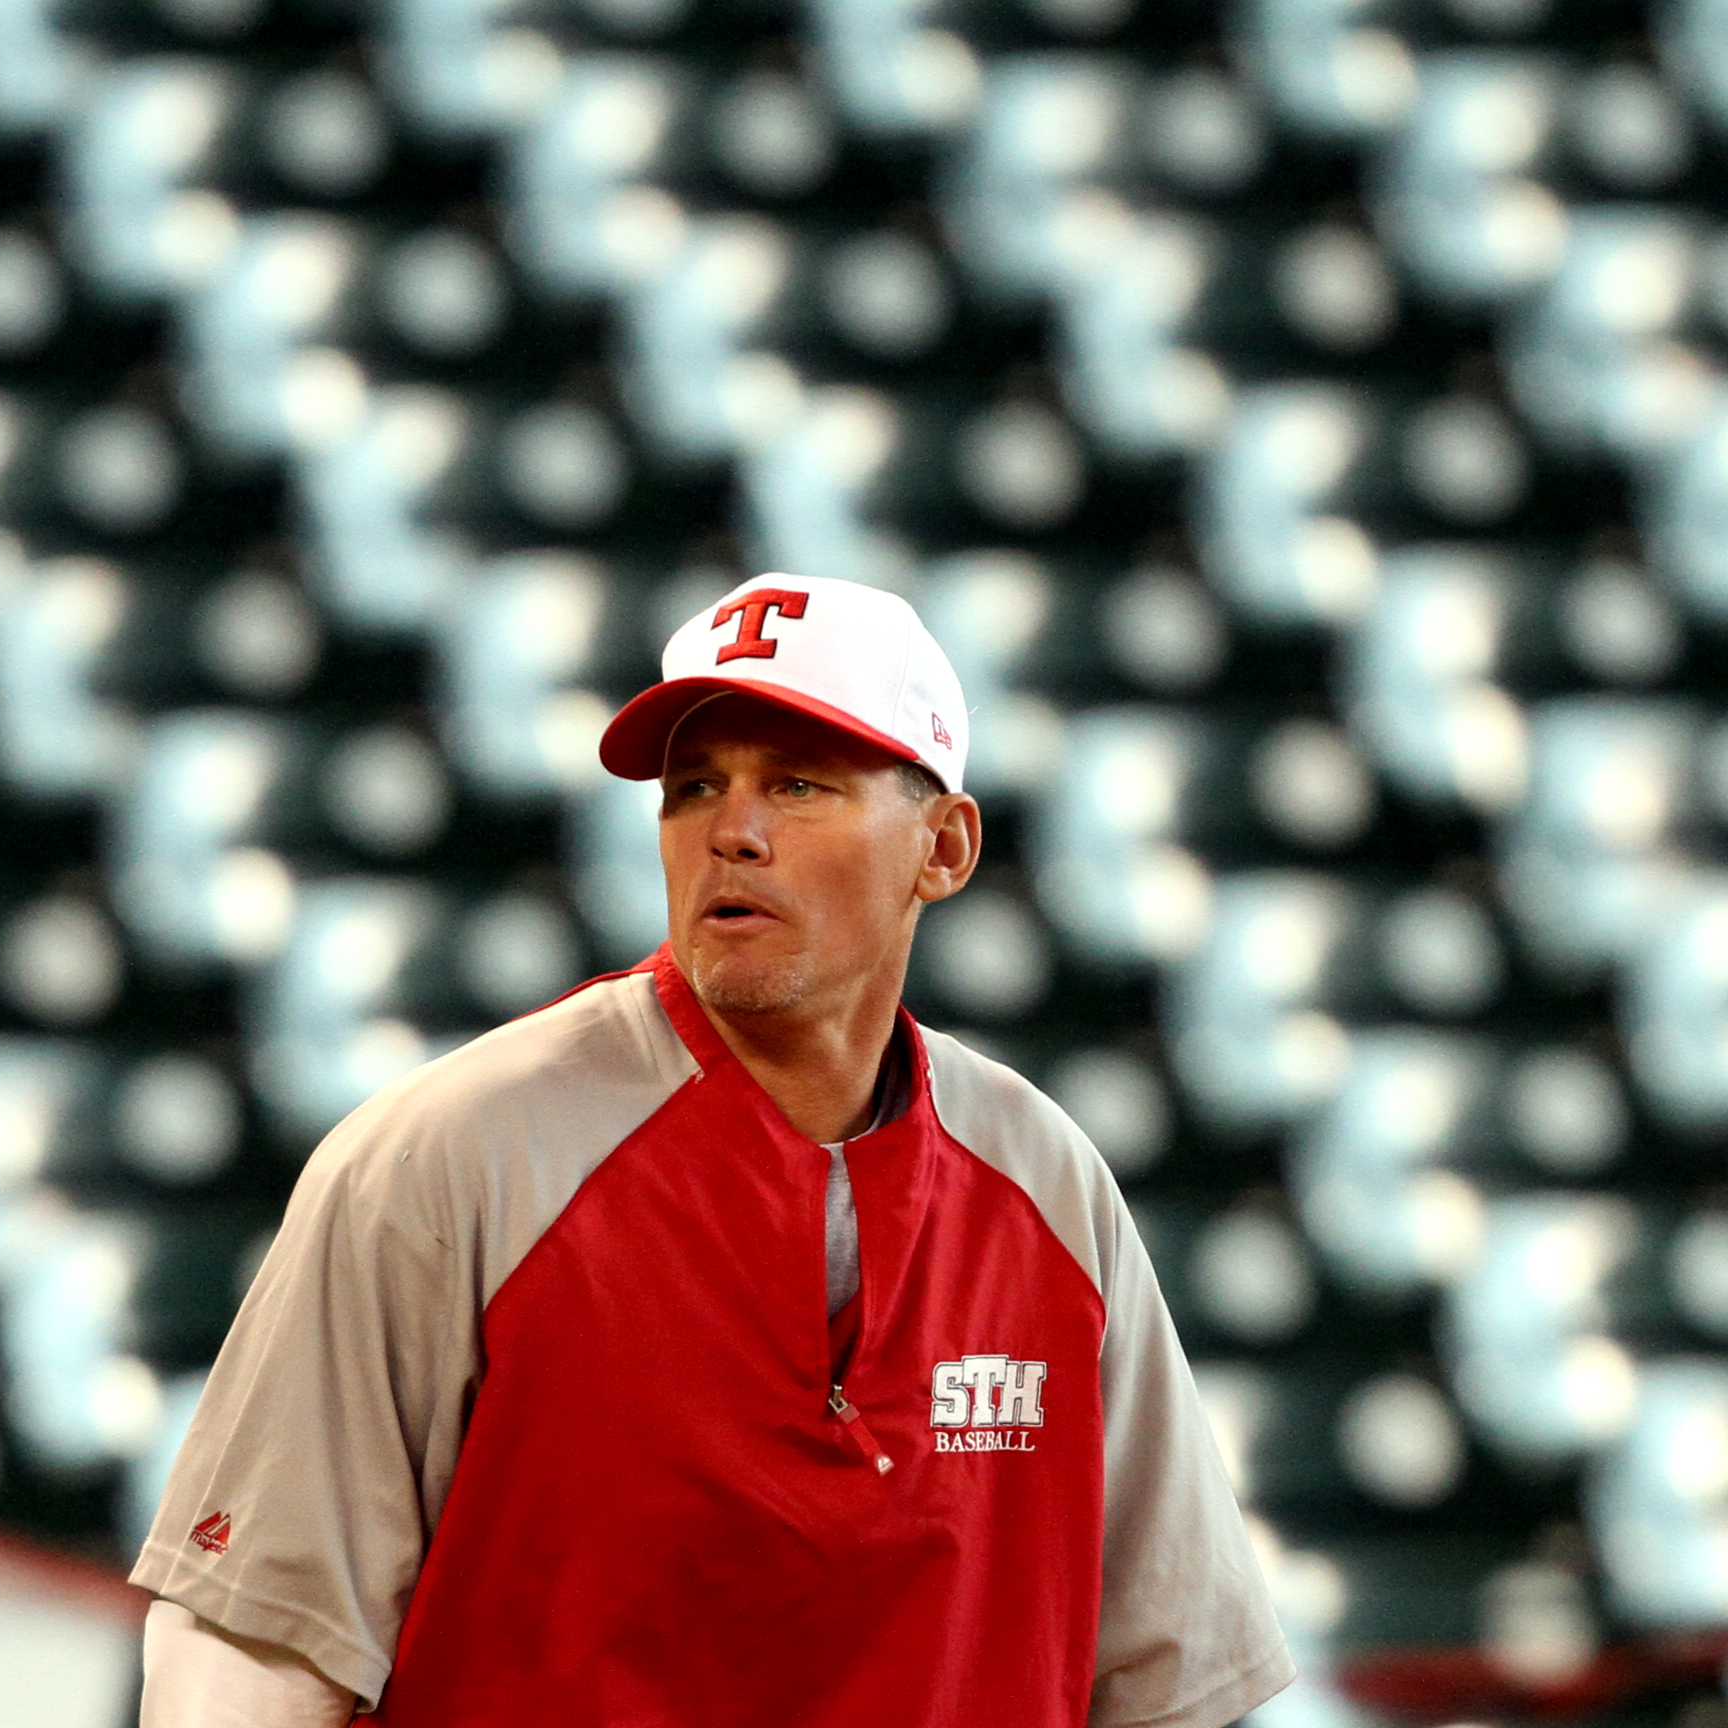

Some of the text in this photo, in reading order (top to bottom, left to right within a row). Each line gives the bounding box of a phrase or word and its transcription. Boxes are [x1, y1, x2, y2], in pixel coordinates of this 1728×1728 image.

[711, 588, 810, 666] T
[930, 1354, 1047, 1428] STH
[934, 1431, 1036, 1452] BASEBALL
